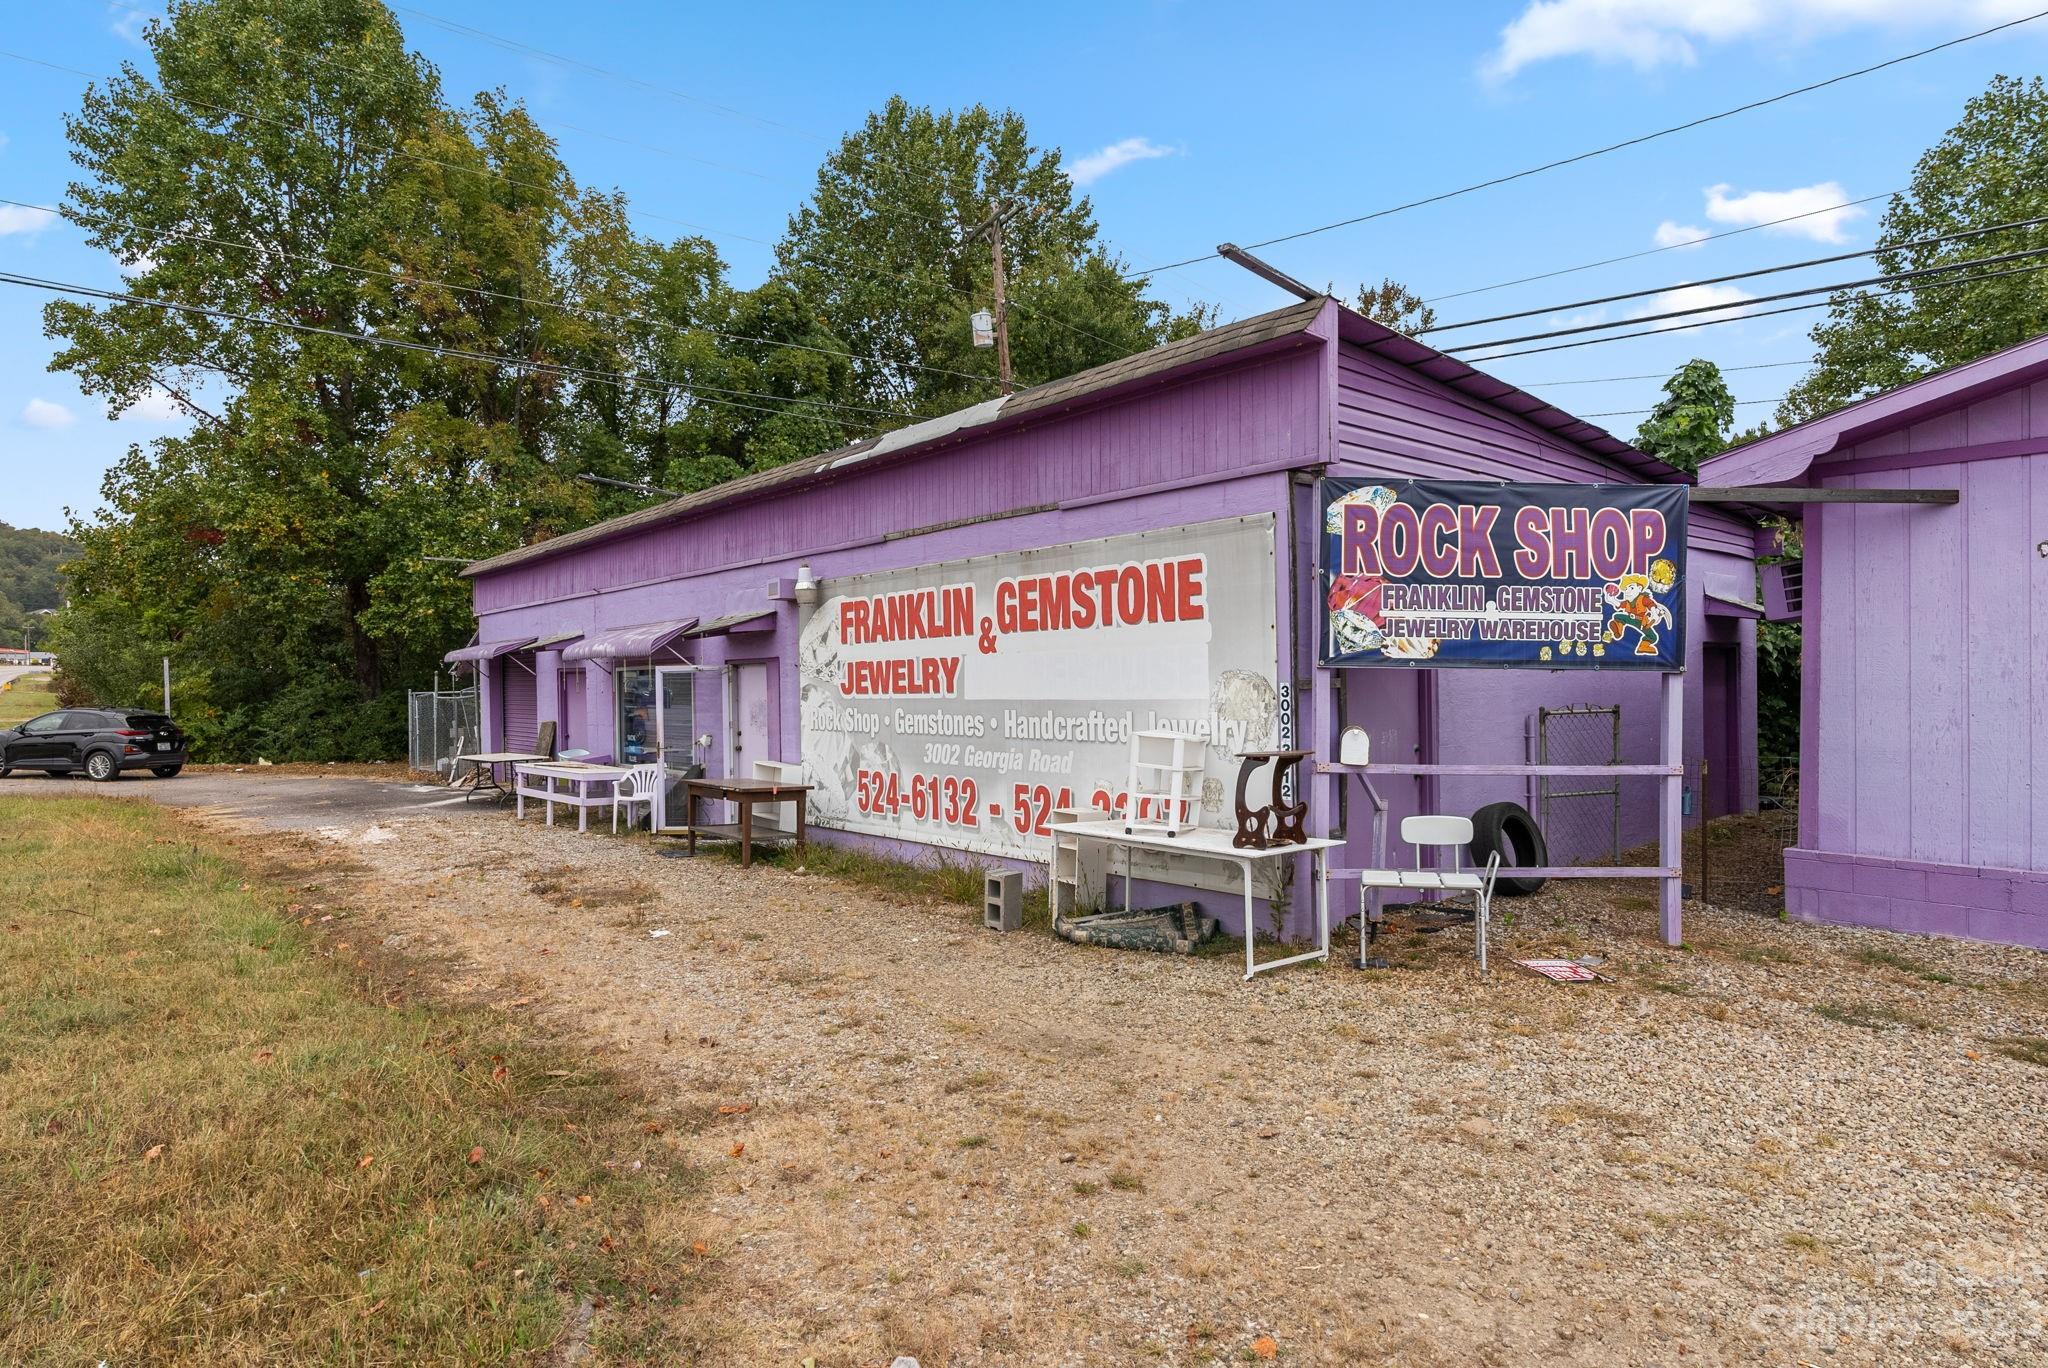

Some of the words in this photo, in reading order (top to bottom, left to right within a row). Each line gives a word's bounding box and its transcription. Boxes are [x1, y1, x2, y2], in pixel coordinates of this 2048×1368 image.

[1341, 502, 1502, 578] ROCK
[1513, 505, 1666, 580] SHOP
[840, 585, 974, 646] FRANKLIN
[978, 615, 998, 655] &
[997, 557, 1205, 634] GEMSTONE
[1382, 584, 1485, 611] FRANKLIN
[1496, 586, 1603, 613] GEMSTONE
[1382, 618, 1474, 640] JEWELRY
[1479, 619, 1602, 641] WAREHOUSE
[840, 656, 960, 696] JEWELRY
[810, 708, 841, 732] Rock
[847, 708, 880, 738] Shop
[894, 708, 984, 737] Gemstones
[1004, 710, 1133, 744] Handcrafted
[924, 742, 959, 766] 3002
[964, 747, 1023, 775] Georgia
[1028, 749, 1074, 775] Road
[856, 769, 979, 828] 524-6132
